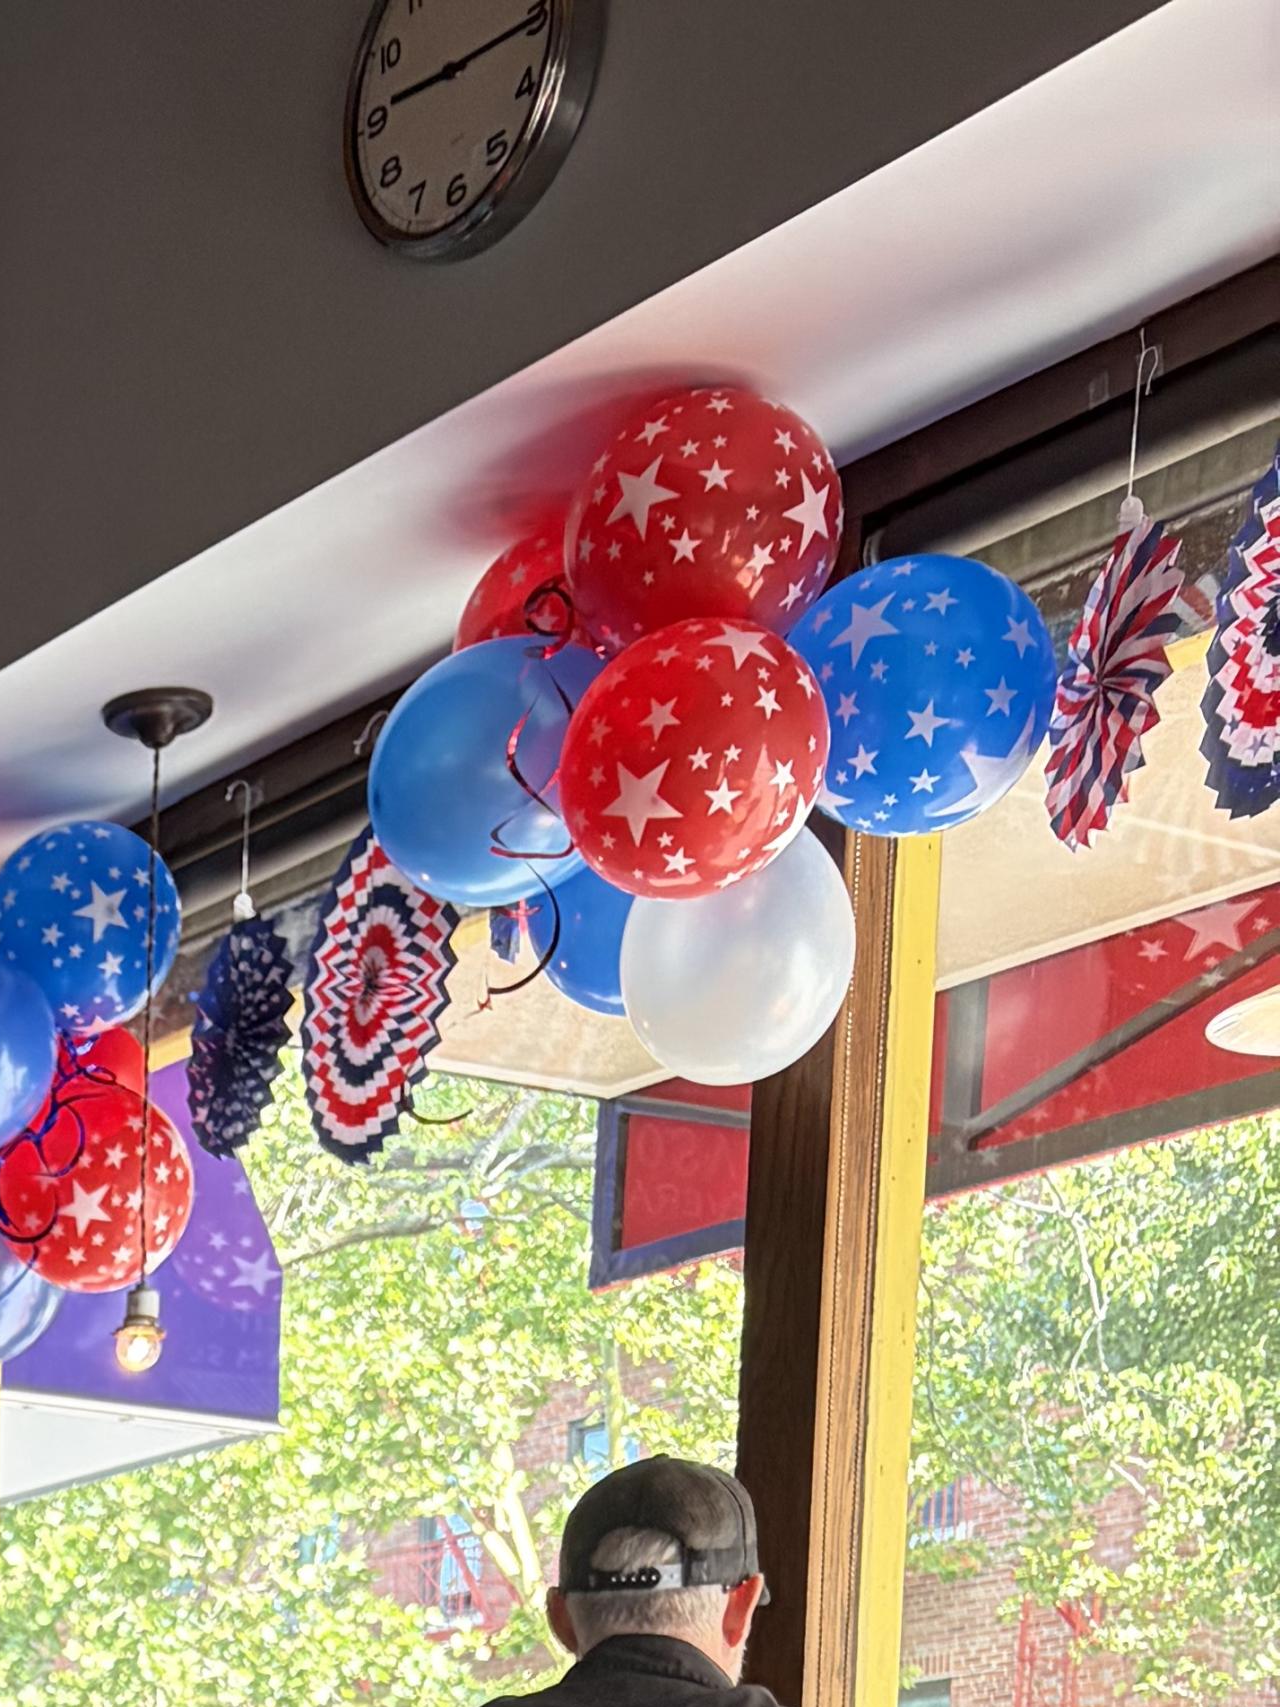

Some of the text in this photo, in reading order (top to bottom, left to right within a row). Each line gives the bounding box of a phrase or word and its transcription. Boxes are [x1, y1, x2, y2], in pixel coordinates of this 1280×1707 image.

[381, 38, 401, 74] 10
[515, 66, 536, 100] 4
[366, 105, 388, 139] 9
[486, 129, 508, 166] 5
[380, 156, 402, 188] 8
[408, 179, 427, 215] 7
[446, 173, 467, 207] 6
